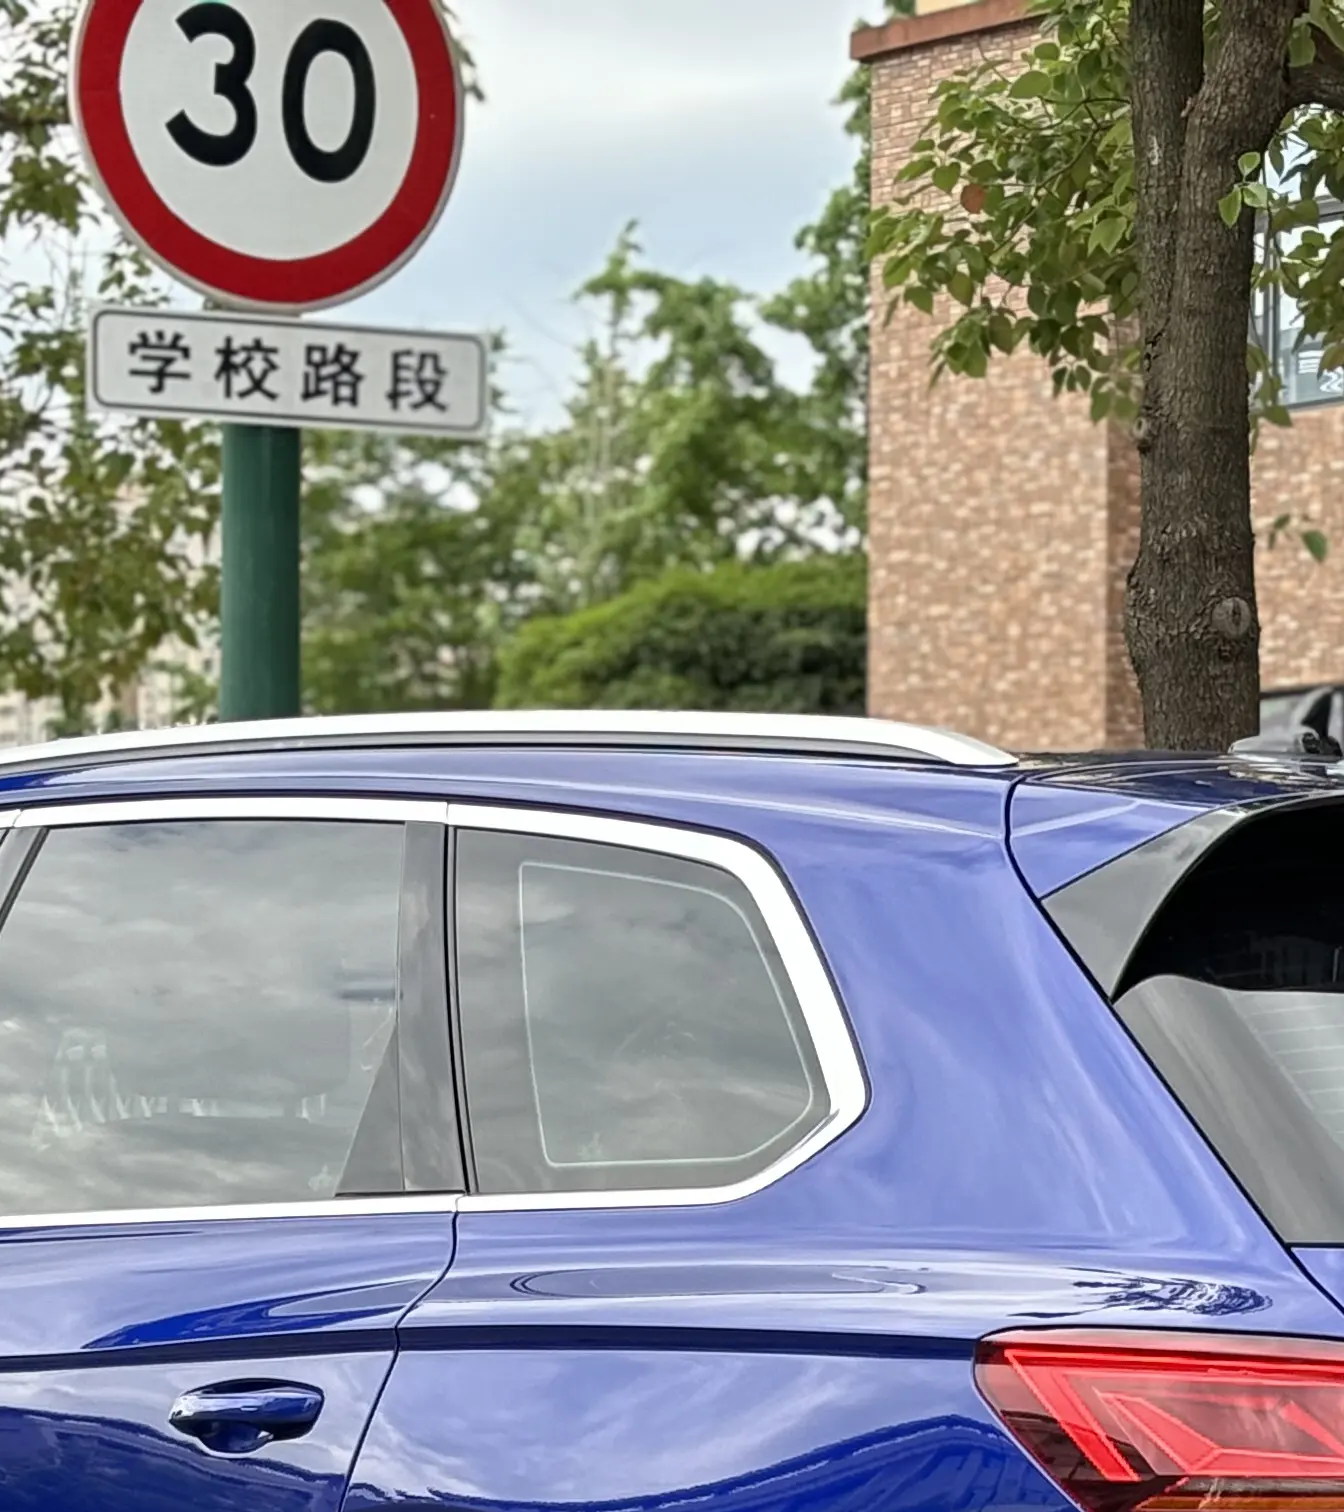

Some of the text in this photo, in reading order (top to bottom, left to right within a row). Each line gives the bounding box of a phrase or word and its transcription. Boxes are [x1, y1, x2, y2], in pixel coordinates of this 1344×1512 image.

[165, 1, 376, 183] 30
[128, 330, 449, 413] 学校路段
